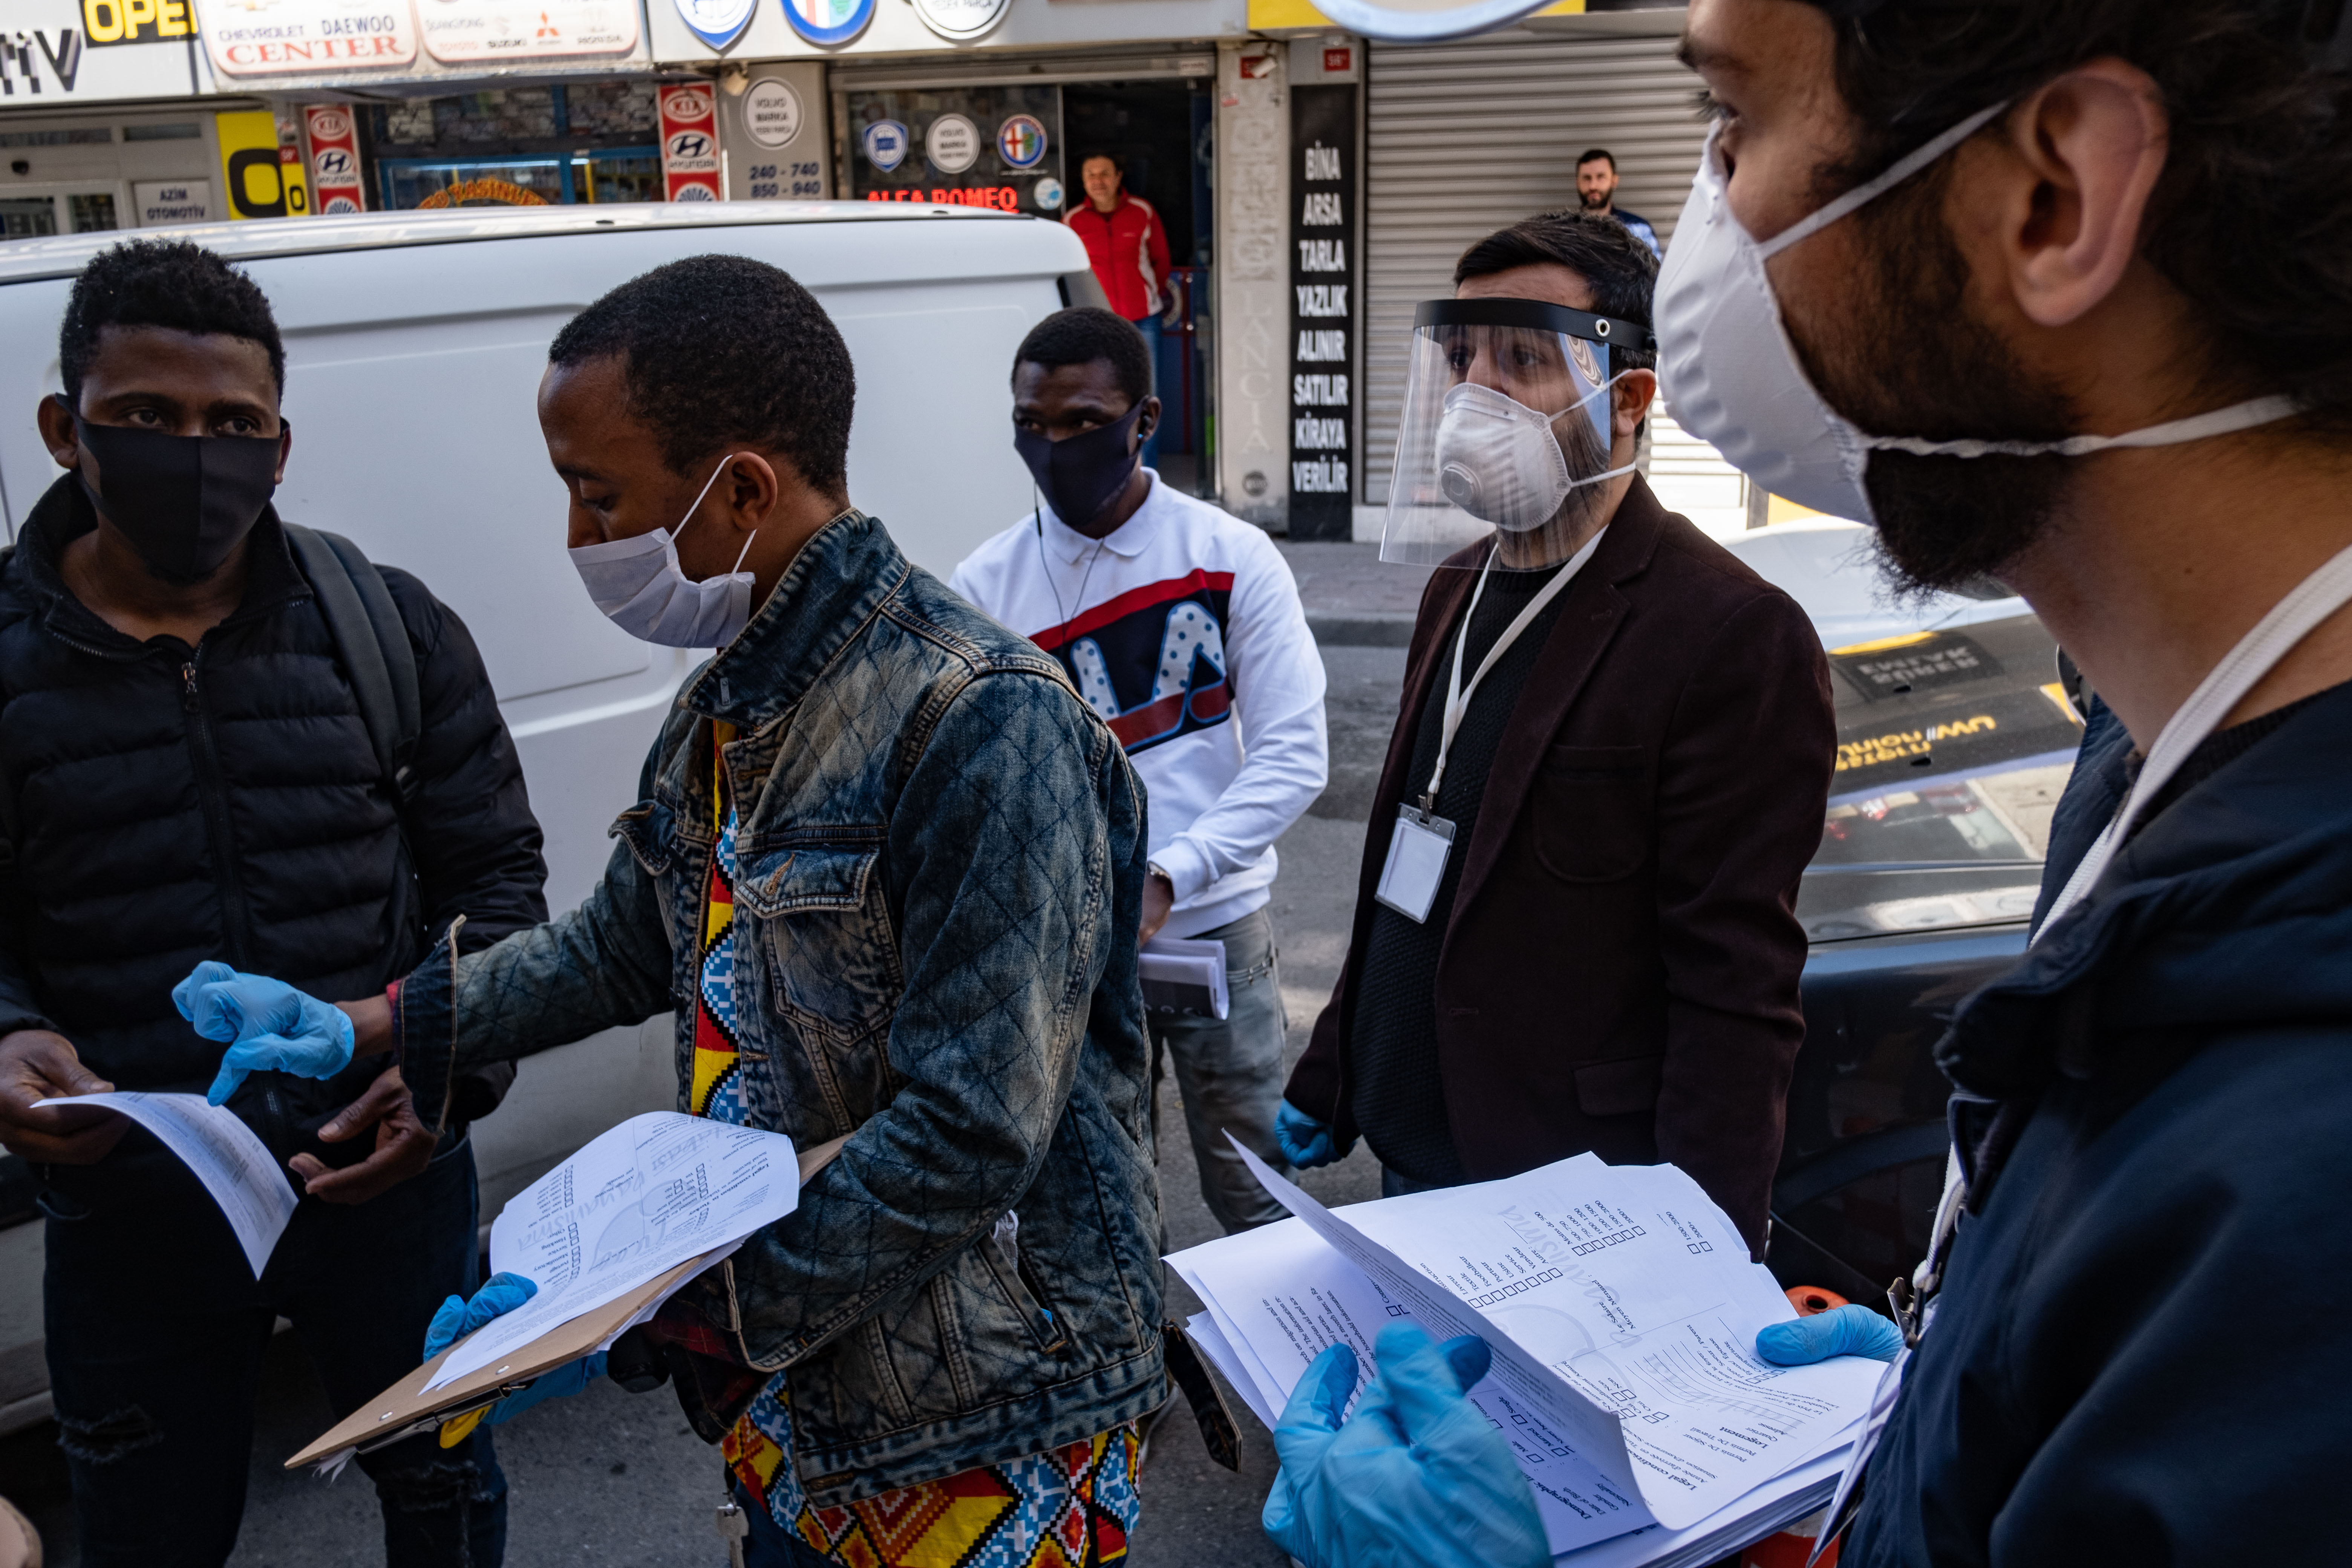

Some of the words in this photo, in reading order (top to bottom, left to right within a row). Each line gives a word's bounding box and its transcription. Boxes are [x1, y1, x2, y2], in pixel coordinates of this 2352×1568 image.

[219, 25, 304, 42] CHEVROLET
[322, 15, 395, 35] DAEWOO
[226, 35, 406, 65] CENTER
[756, 97, 787, 109] VOLVO
[1305, 140, 1341, 180] BİNA
[750, 165, 776, 180] 240
[790, 162, 819, 177] 740
[160, 186, 186, 201] AZİM
[752, 182, 779, 198] 850
[793, 180, 820, 196] 940
[147, 204, 205, 220] OTOMOTİV
[1303, 193, 1343, 225] ARSA
[1298, 239, 1346, 271] TARLA
[1296, 285, 1347, 317] YAZLIK
[1297, 330, 1346, 361] ALINIR
[1294, 374, 1348, 406] SATILIR
[1295, 411, 1346, 449] KİRAYA
[1292, 455, 1348, 492] VERİLİR
[752, 1163, 769, 1176] Legal
[689, 1201, 709, 1216] Turkey
[1534, 1211, 1547, 1221] 500
[1584, 1204, 1614, 1231] 1200-1500
[1595, 1200, 1624, 1228] 1500-2000
[1617, 1207, 1635, 1224] 2000+
[1559, 1220, 1583, 1241] 500-750
[1566, 1214, 1594, 1238] 750-1000
[1574, 1208, 1604, 1235] 1000-1200
[1666, 1211, 1692, 1240] 1500-2000
[1687, 1220, 1703, 1239] 2000+
[1554, 1227, 1573, 1245] Moins
[1505, 1254, 1526, 1274] Service
[1513, 1246, 1536, 1270] Vendeur
[1459, 1256, 1492, 1287] Footballeur
[1481, 1261, 1504, 1282] Porteur
[1497, 1262, 1514, 1278] Usine
[1309, 1286, 1318, 1295] Ra-
[1446, 1275, 1468, 1295] Livreur
[1460, 1272, 1479, 1292] Textile
[1262, 1297, 1270, 1307] im-
[1289, 1295, 1297, 1306] aca-
[1592, 1280, 1617, 1306] Mensuel
[1266, 1306, 1278, 1317] and
[1294, 1305, 1306, 1317] and
[1321, 1301, 1333, 1315] later,
[1327, 1289, 1352, 1322] information.
[1599, 1301, 1618, 1323] Salaire
[1280, 1303, 1304, 1333] information
[1302, 1316, 1312, 1325] aid
[1329, 1314, 1345, 1333] month
[1616, 1306, 1636, 1330] Moyen
[1276, 1316, 1297, 1342] migration
[1348, 1320, 1371, 1352] household
[1617, 1323, 1626, 1334] Le
[1687, 1324, 1704, 1345] Parent
[1295, 1342, 1303, 1351] on
[1302, 1333, 1312, 1344] The
[1348, 1337, 1361, 1357] below,
[1707, 1349, 1725, 1367] Soeur
[1724, 1341, 1762, 1372] Compatriote
[1358, 1356, 1375, 1379] number
[1561, 1360, 1583, 1378] Assuré
[1598, 1380, 1613, 1391] Non
[1608, 1377, 1622, 1389] Non
[1582, 1378, 1623, 1408] Actuellement
[1628, 1403, 1642, 1413] Oui
[1637, 1401, 1651, 1411] Oui
[1470, 1398, 1491, 1418] Female
[1512, 1440, 1529, 1452] Male
[1498, 1396, 1516, 1413] Single
[1527, 1427, 1554, 1447] Married
[1757, 1423, 1788, 1435] Adresse
[1683, 1433, 1707, 1446] Séjour
[1690, 1427, 1717, 1440] Travail
[1720, 1426, 1769, 1449] Logement
[1745, 1426, 1778, 1442] Quartier
[1644, 1441, 1685, 1462] d'Assurance
[1721, 1449, 1747, 1463] Permis
[1731, 1443, 1757, 1456] Permis
[1650, 1453, 1682, 1470] d'arrivée
[1686, 1461, 1718, 1479] Situation
[1668, 1474, 1698, 1491] Legal
[1682, 1469, 1708, 1483] Année
[1534, 1481, 1593, 1520] Demographic
[1563, 1487, 1580, 1499] Birth
[1593, 1494, 1619, 1510] Gender
[1594, 1483, 1633, 1507] Nationality
[1588, 1503, 1606, 1516] Date
